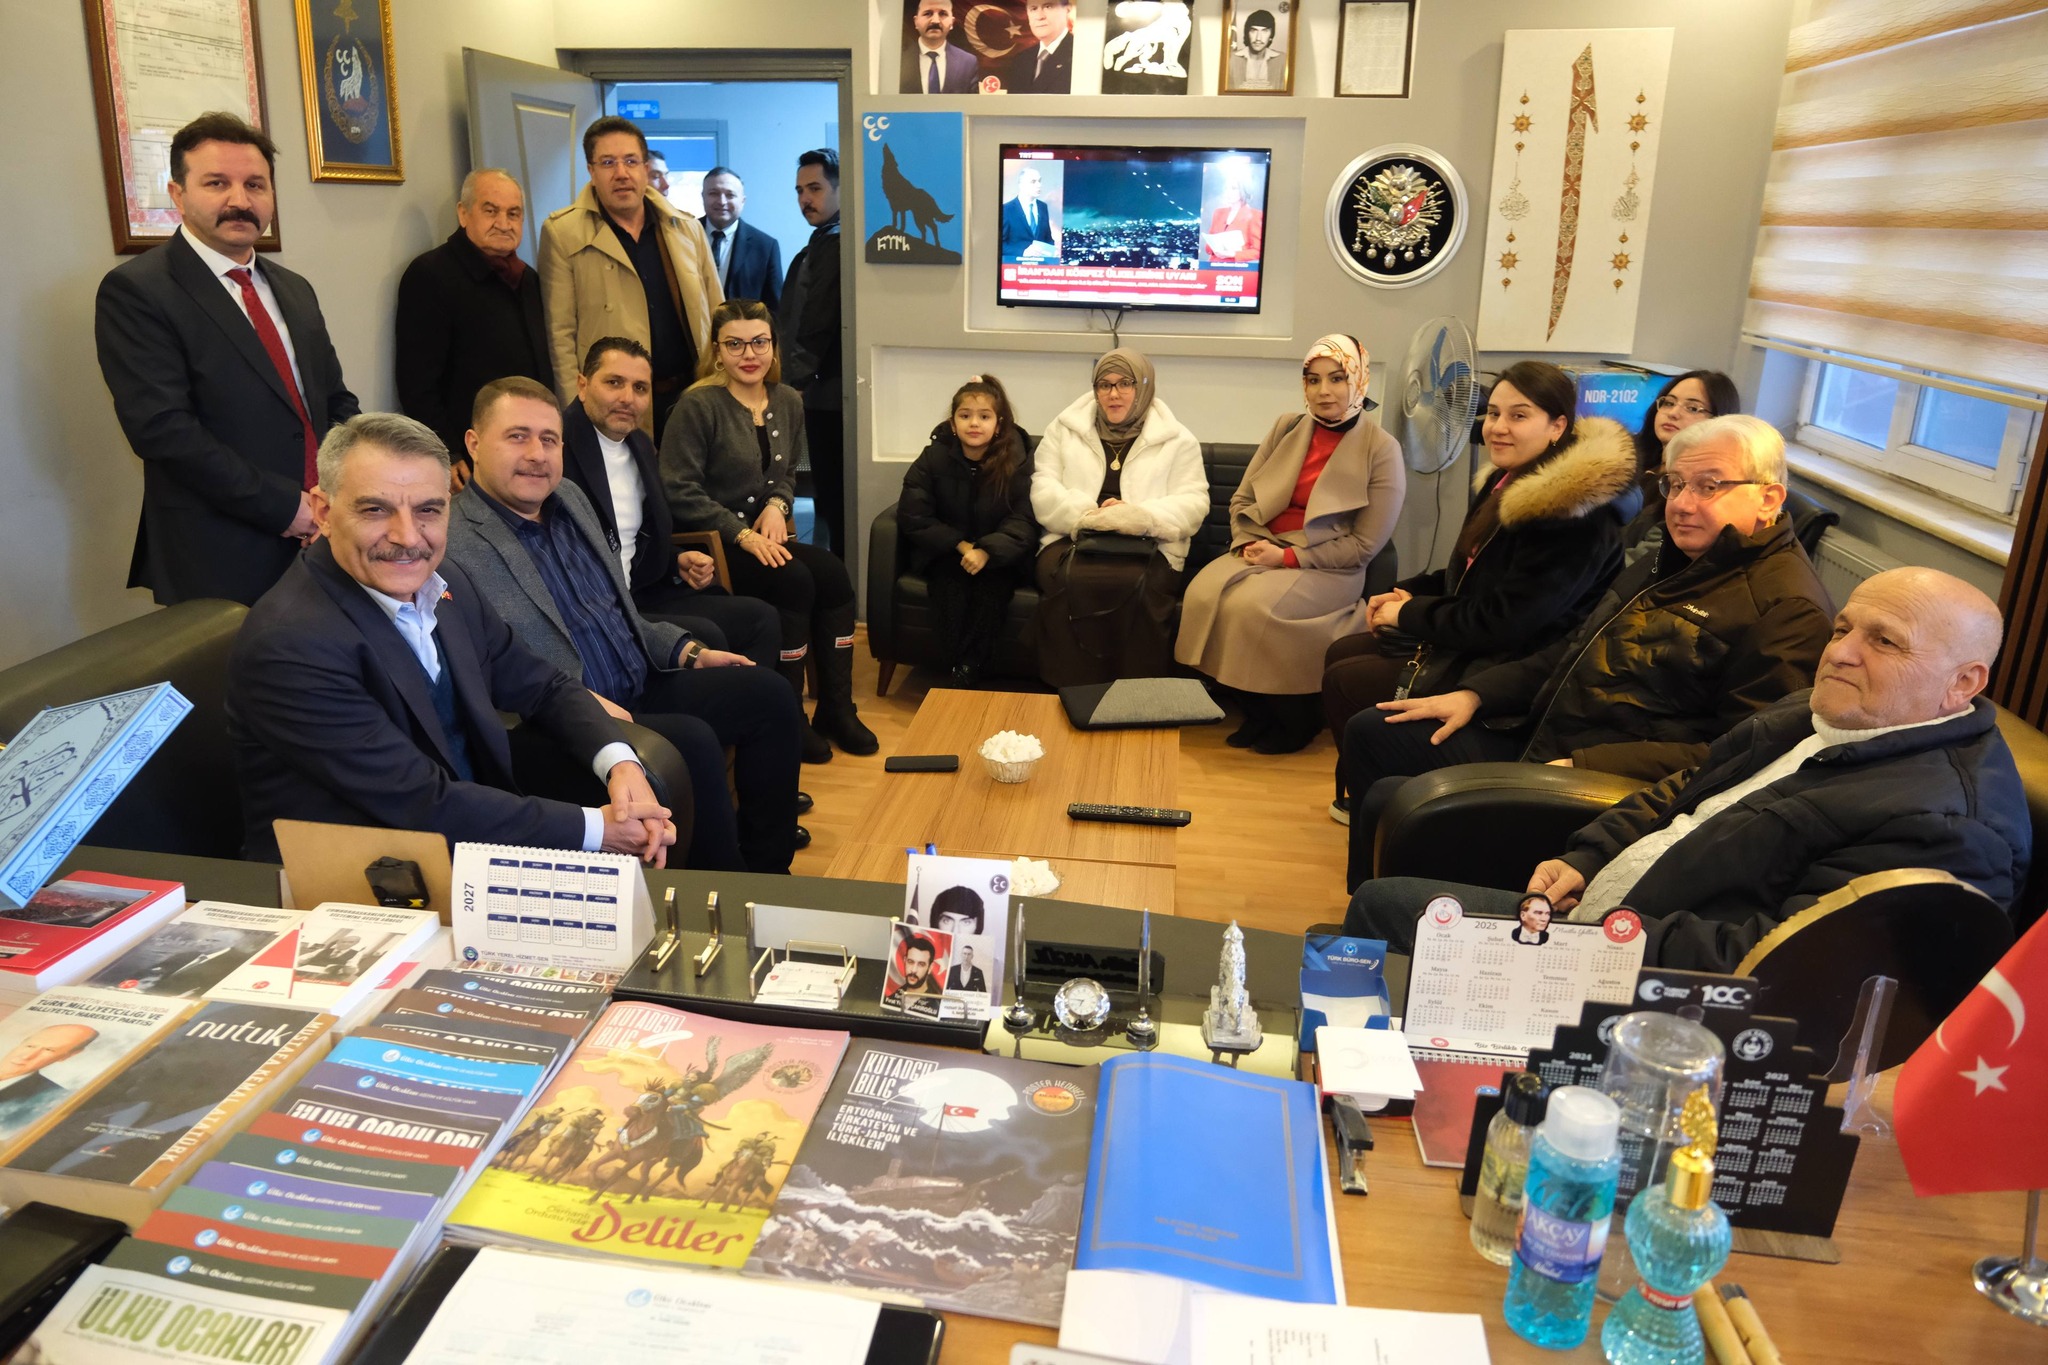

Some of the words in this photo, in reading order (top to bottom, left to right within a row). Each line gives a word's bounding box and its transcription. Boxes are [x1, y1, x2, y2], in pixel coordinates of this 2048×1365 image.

[1584, 390, 1639, 403] NDR-2102
[464, 883, 475, 912] 2027
[1474, 921, 1498, 930] 2025
[37, 1000, 67, 1009] TÜRK
[149, 1012, 164, 1021] VE
[77, 1010, 119, 1022] HAREKET
[186, 1020, 293, 1047] nutuk
[266, 1021, 324, 1067] MUSTAFA
[1568, 1051, 1592, 1061] 2024
[227, 1069, 272, 1103] KEMAL
[1765, 1071, 1789, 1081] 2025
[839, 1104, 894, 1123] ERTUĞRUL
[826, 1130, 887, 1151] İLİŞKİLERİ
[831, 1122, 902, 1144] TÜRK-JAPON
[903, 1126, 918, 1137] VE
[571, 1200, 744, 1255] Deliler
[77, 1287, 171, 1343] ÜLKÜ
[156, 1304, 315, 1365] OCAKLARI
